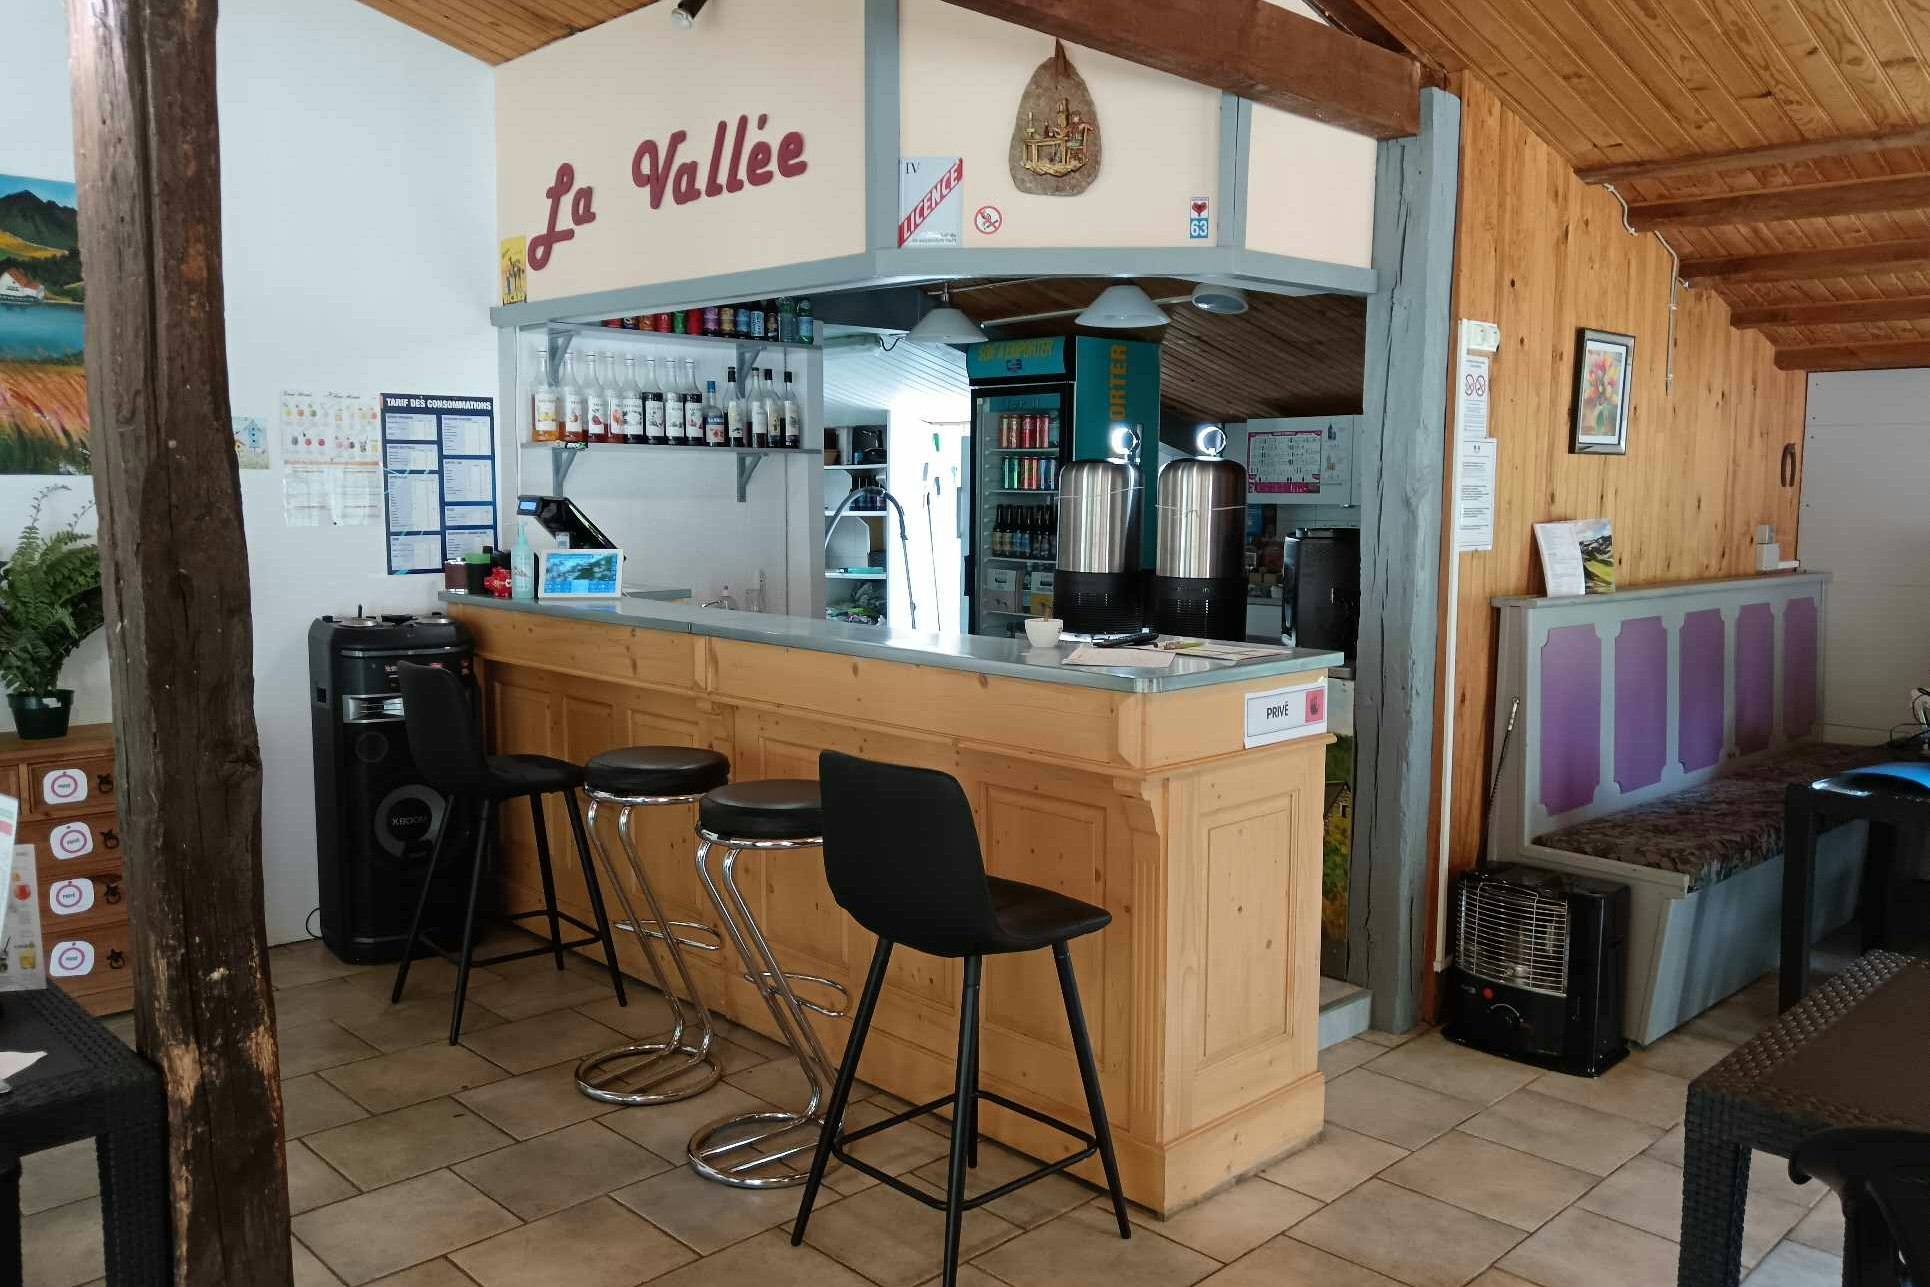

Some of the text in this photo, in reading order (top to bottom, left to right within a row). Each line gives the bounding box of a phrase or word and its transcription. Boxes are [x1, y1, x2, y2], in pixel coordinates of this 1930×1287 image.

[527, 112, 809, 272] La Vallée
[902, 160, 960, 241] LICENCE
[1190, 220, 1208, 236] 63
[385, 397, 409, 408] TARIF
[427, 399, 492, 411] CONSOMMATIONS
[1266, 701, 1289, 719] PRIVÉ
